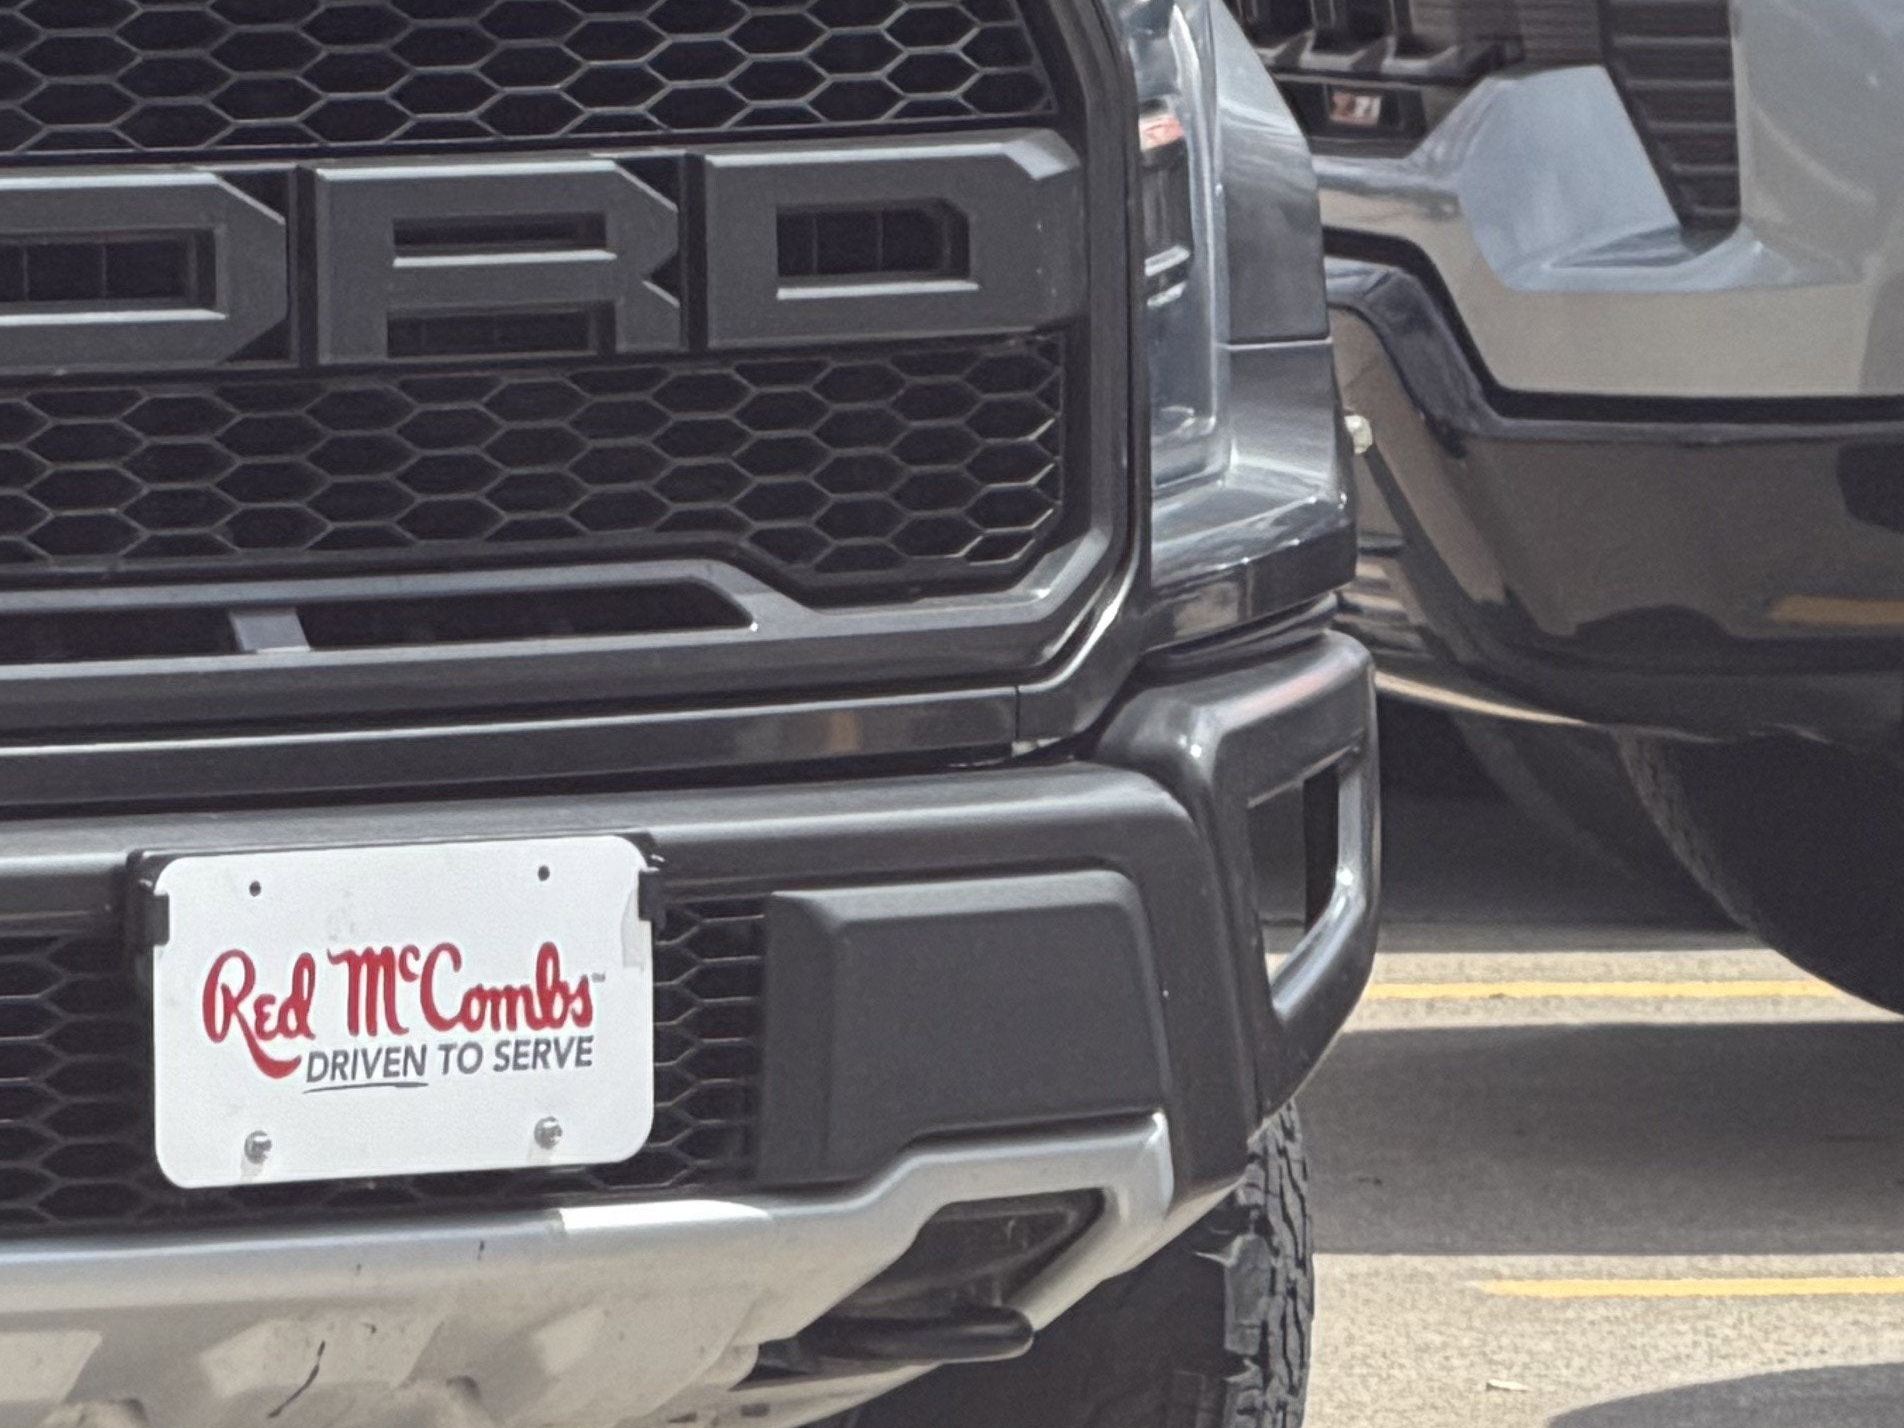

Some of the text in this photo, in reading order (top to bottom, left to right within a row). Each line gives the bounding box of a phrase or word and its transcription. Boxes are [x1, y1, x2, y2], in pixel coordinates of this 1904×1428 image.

[202, 942, 592, 1079] Red McCombs
[305, 1035, 594, 1084] DRIVEN TO SERVE
